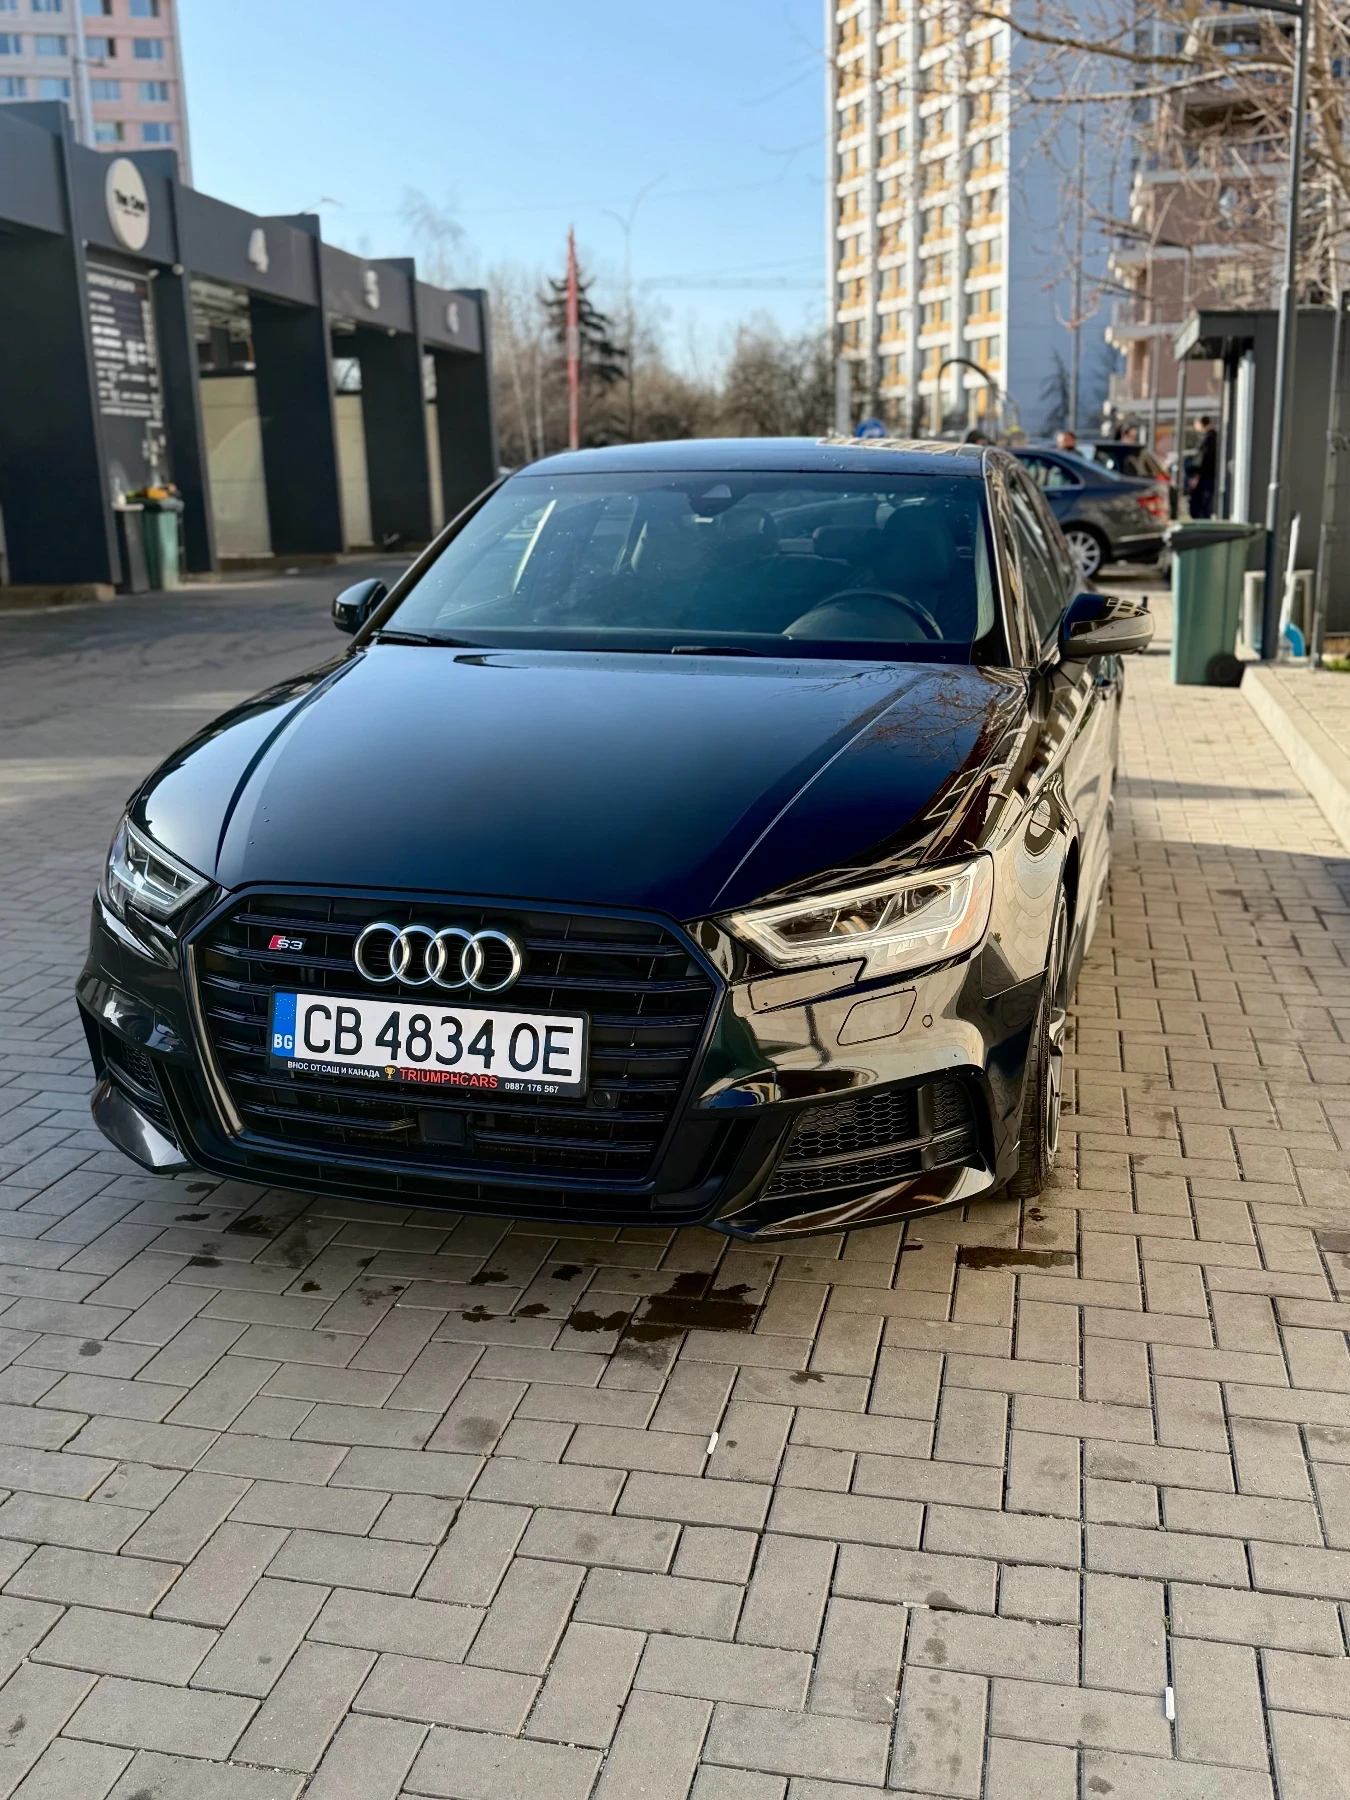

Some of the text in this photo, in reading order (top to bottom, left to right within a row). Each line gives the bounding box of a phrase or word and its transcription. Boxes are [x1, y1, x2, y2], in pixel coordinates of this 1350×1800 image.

[277, 939, 303, 950] S3
[273, 1033, 293, 1050] BG
[375, 1010, 495, 1069] 4834
[287, 1060, 309, 1070] ВНОС
[341, 1066, 347, 1074] И
[348, 1067, 381, 1079] КАНАДА
[400, 1068, 498, 1089] TRIUMPHCARS
[505, 1082, 559, 1094] 0887 176 567
